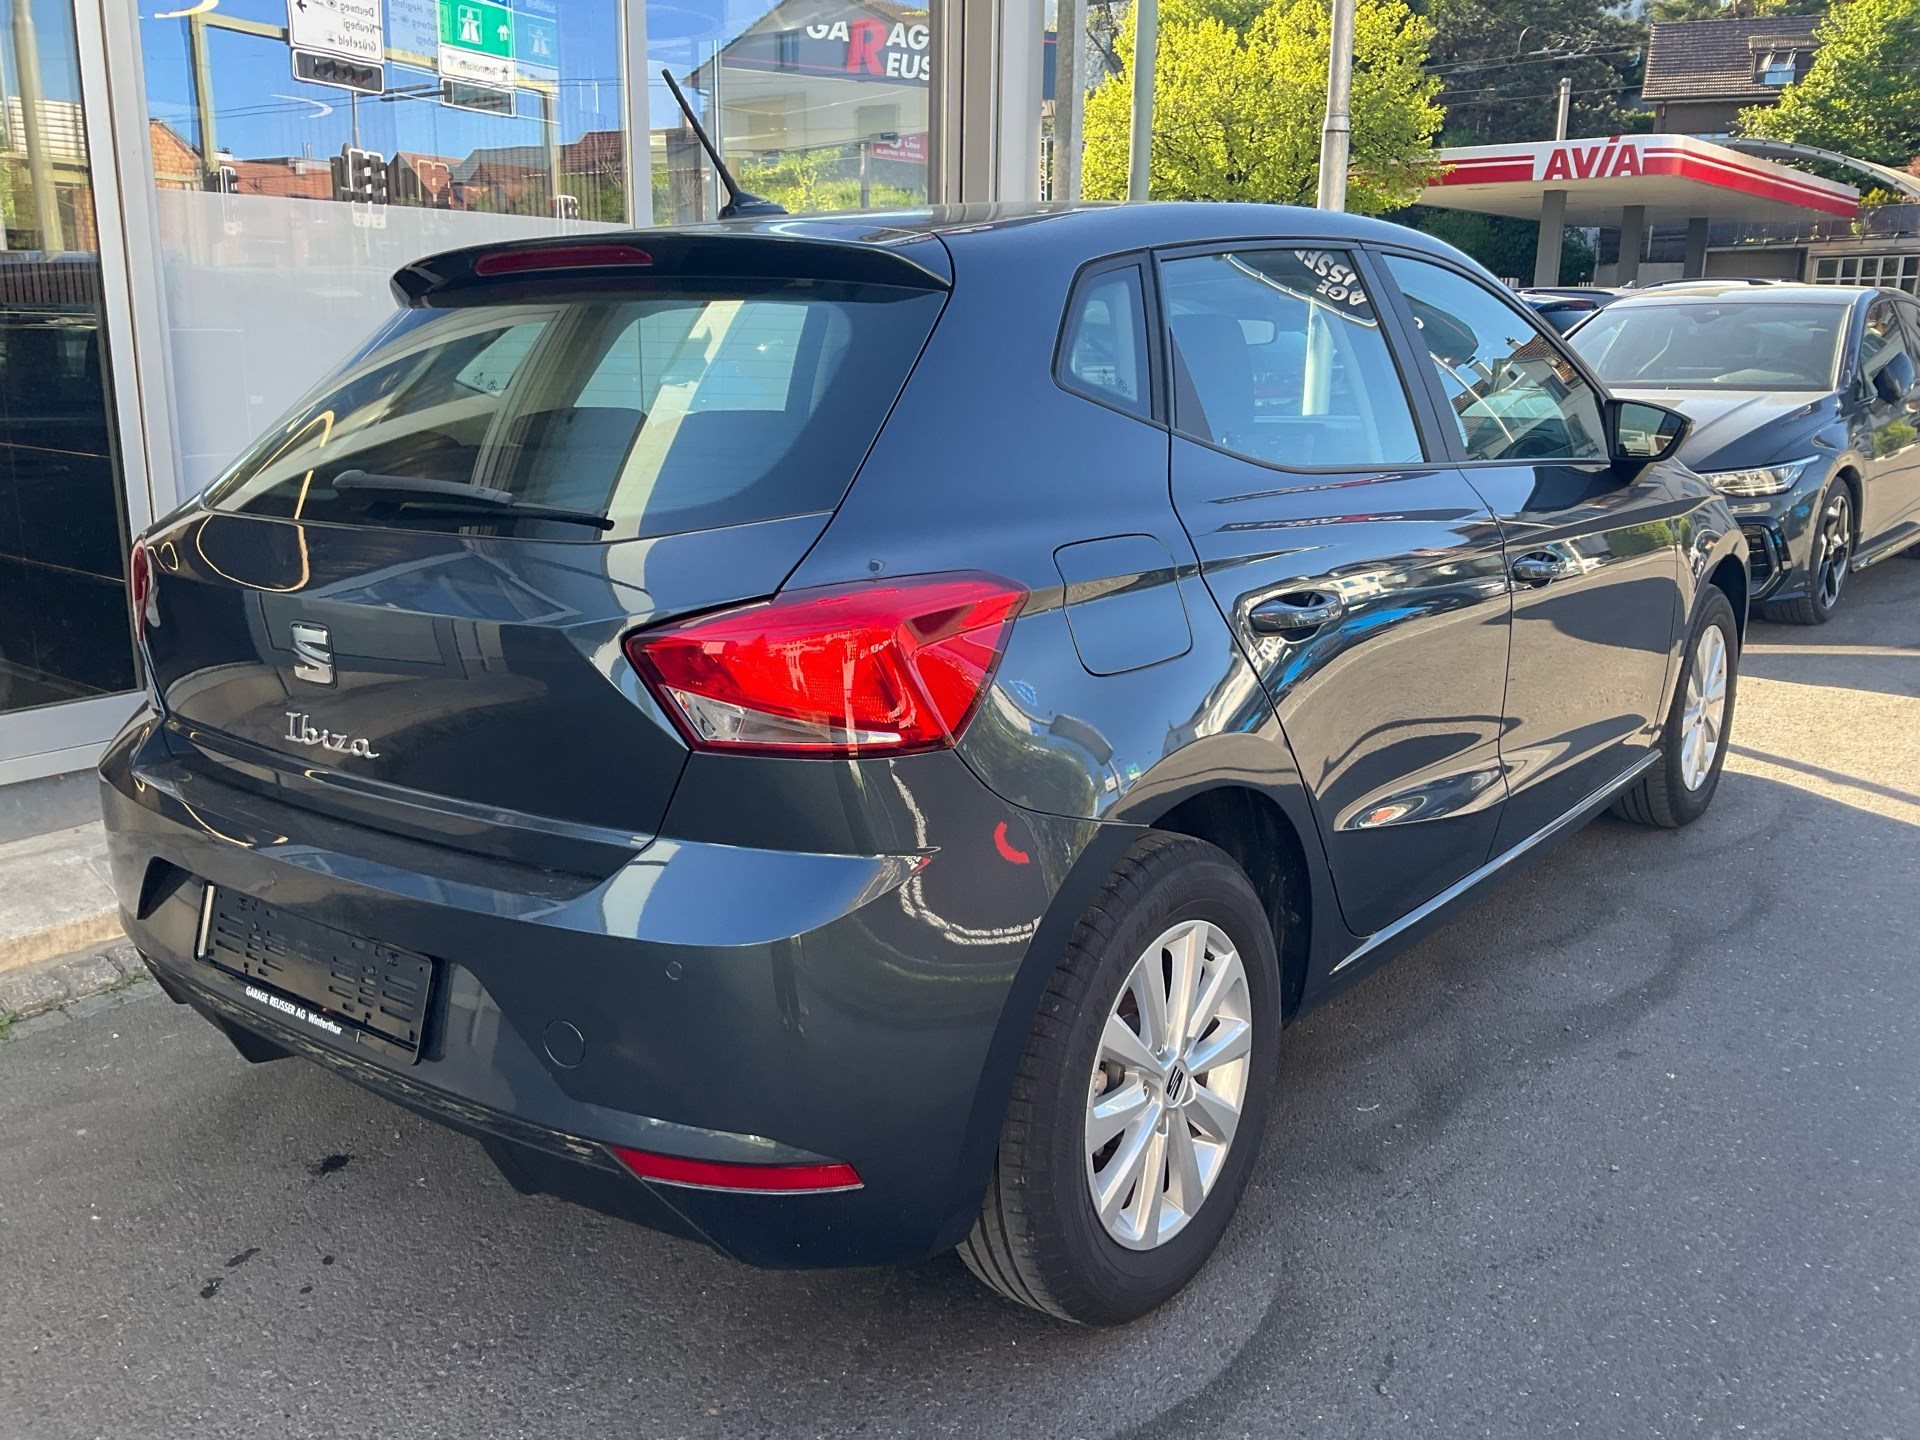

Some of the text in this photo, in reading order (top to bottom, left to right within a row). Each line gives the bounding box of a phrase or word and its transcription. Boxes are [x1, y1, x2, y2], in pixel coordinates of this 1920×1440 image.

[284, 711, 381, 759] Ibiza
[246, 986, 342, 1035] GARAGE REUSSER AG Winterthur
